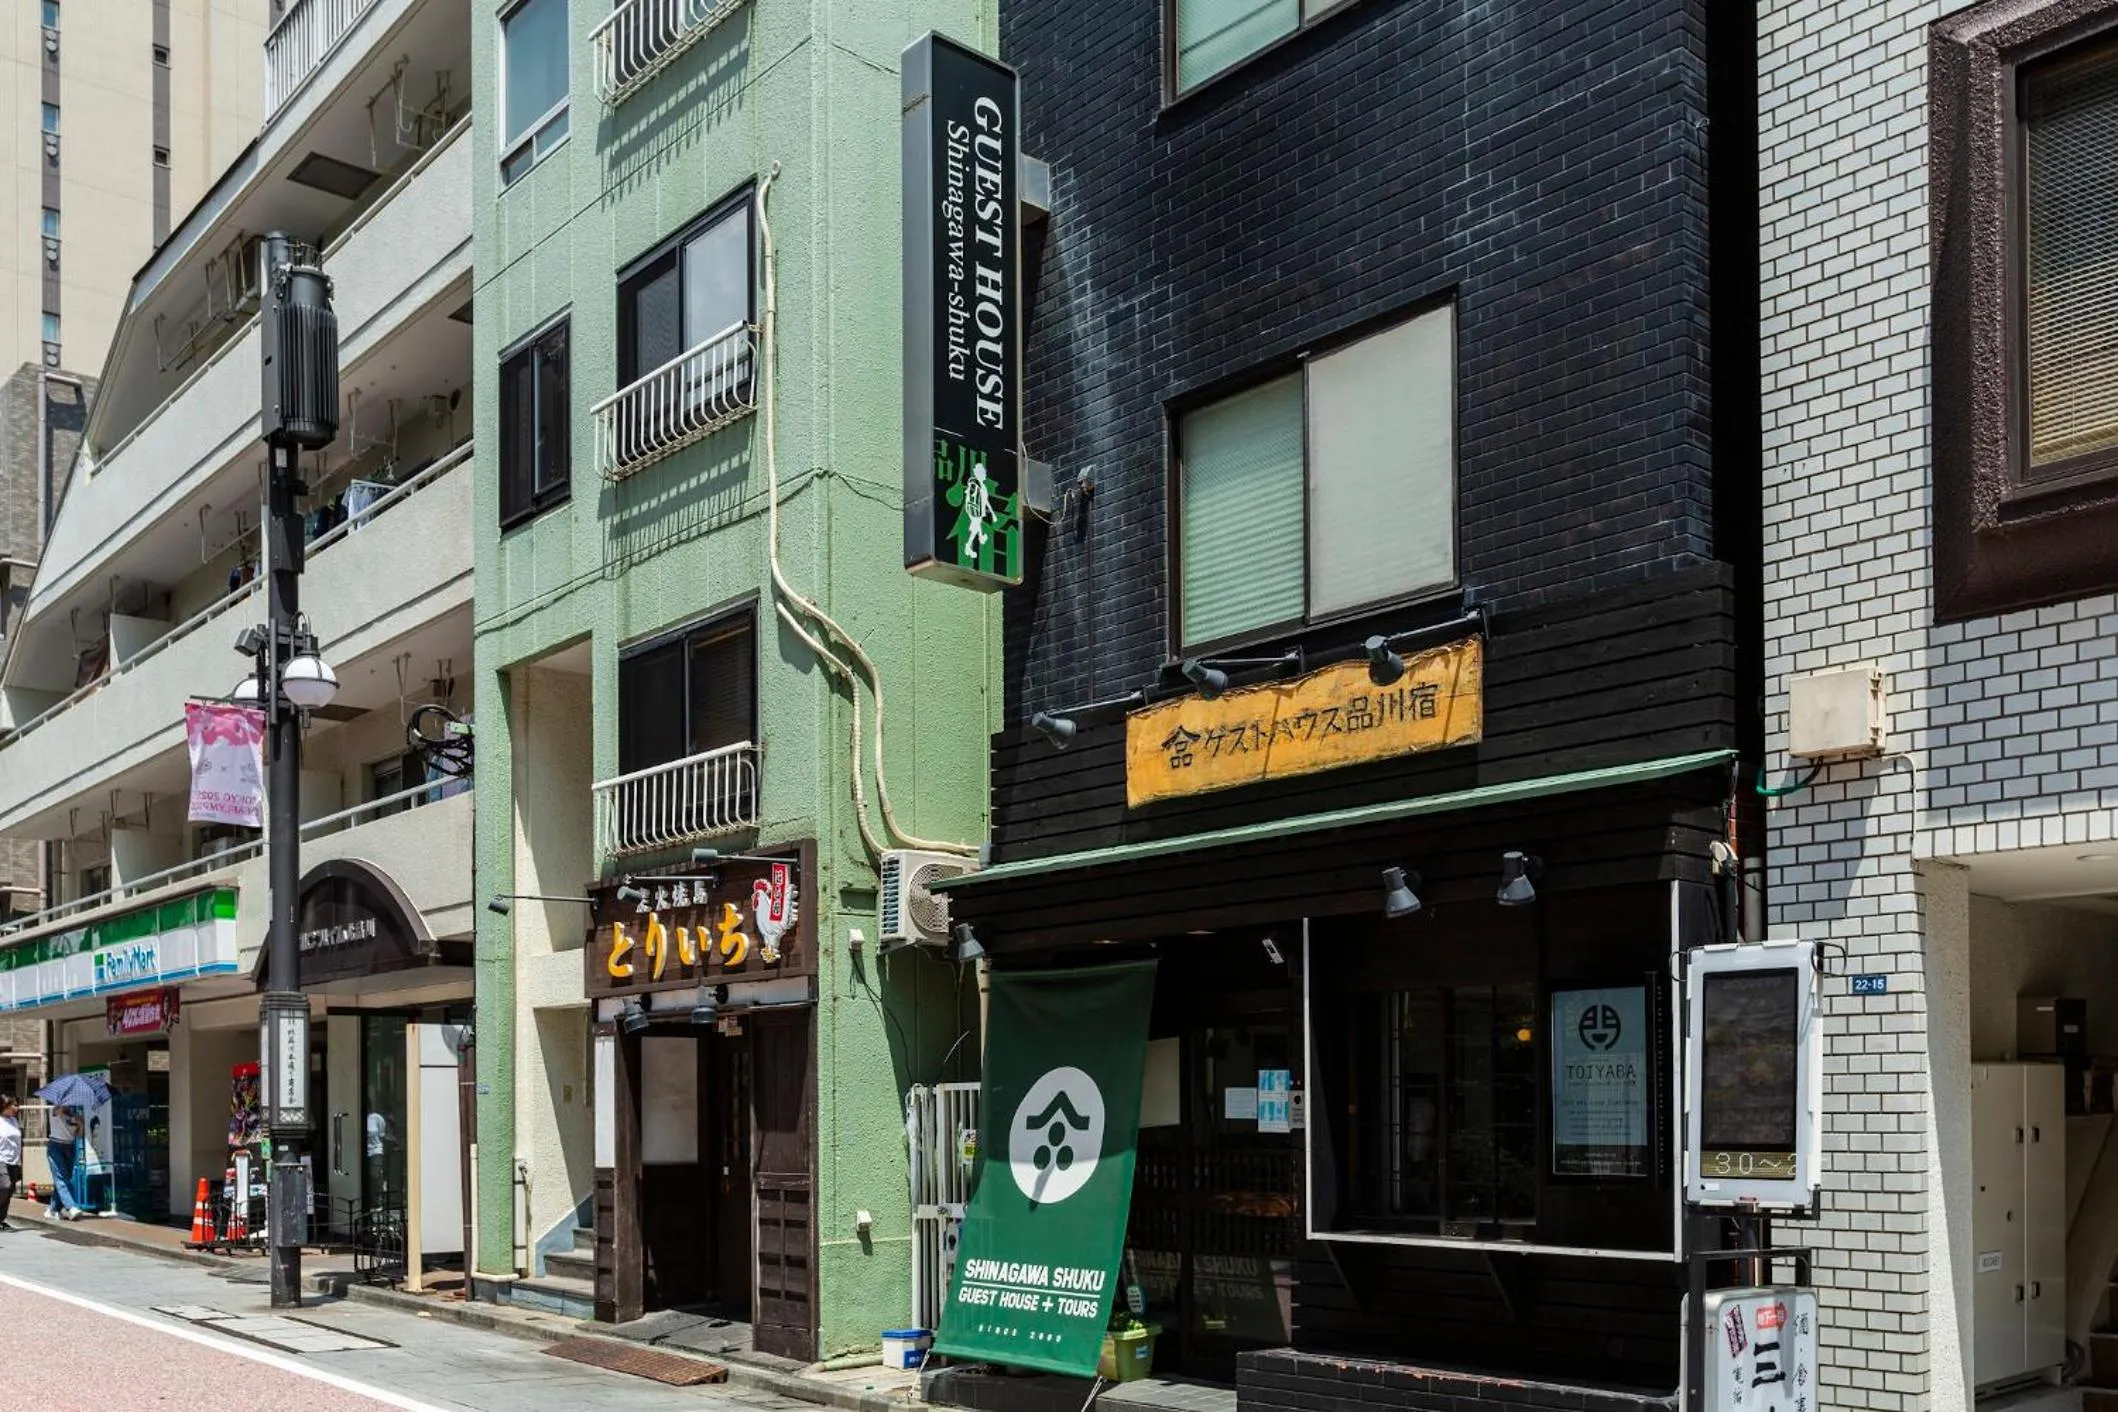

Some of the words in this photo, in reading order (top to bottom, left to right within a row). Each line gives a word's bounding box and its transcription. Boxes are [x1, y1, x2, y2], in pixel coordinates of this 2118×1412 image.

[973, 96, 1003, 258] GUEST
[942, 119, 971, 381] Shinagawa-shuku
[975, 262, 1004, 430] HOUSE
[106, 944, 157, 976] FamilyMart
[608, 902, 749, 980] とりいち
[1566, 1064, 1636, 1081] TOIYABA
[958, 1287, 996, 1306] GUEST
[999, 1291, 1040, 1312] HOUSE
[1058, 1297, 1099, 1318] TOURS
[964, 1259, 1049, 1287] SHINAGAWA
[1053, 1269, 1106, 1292] SHUKU
